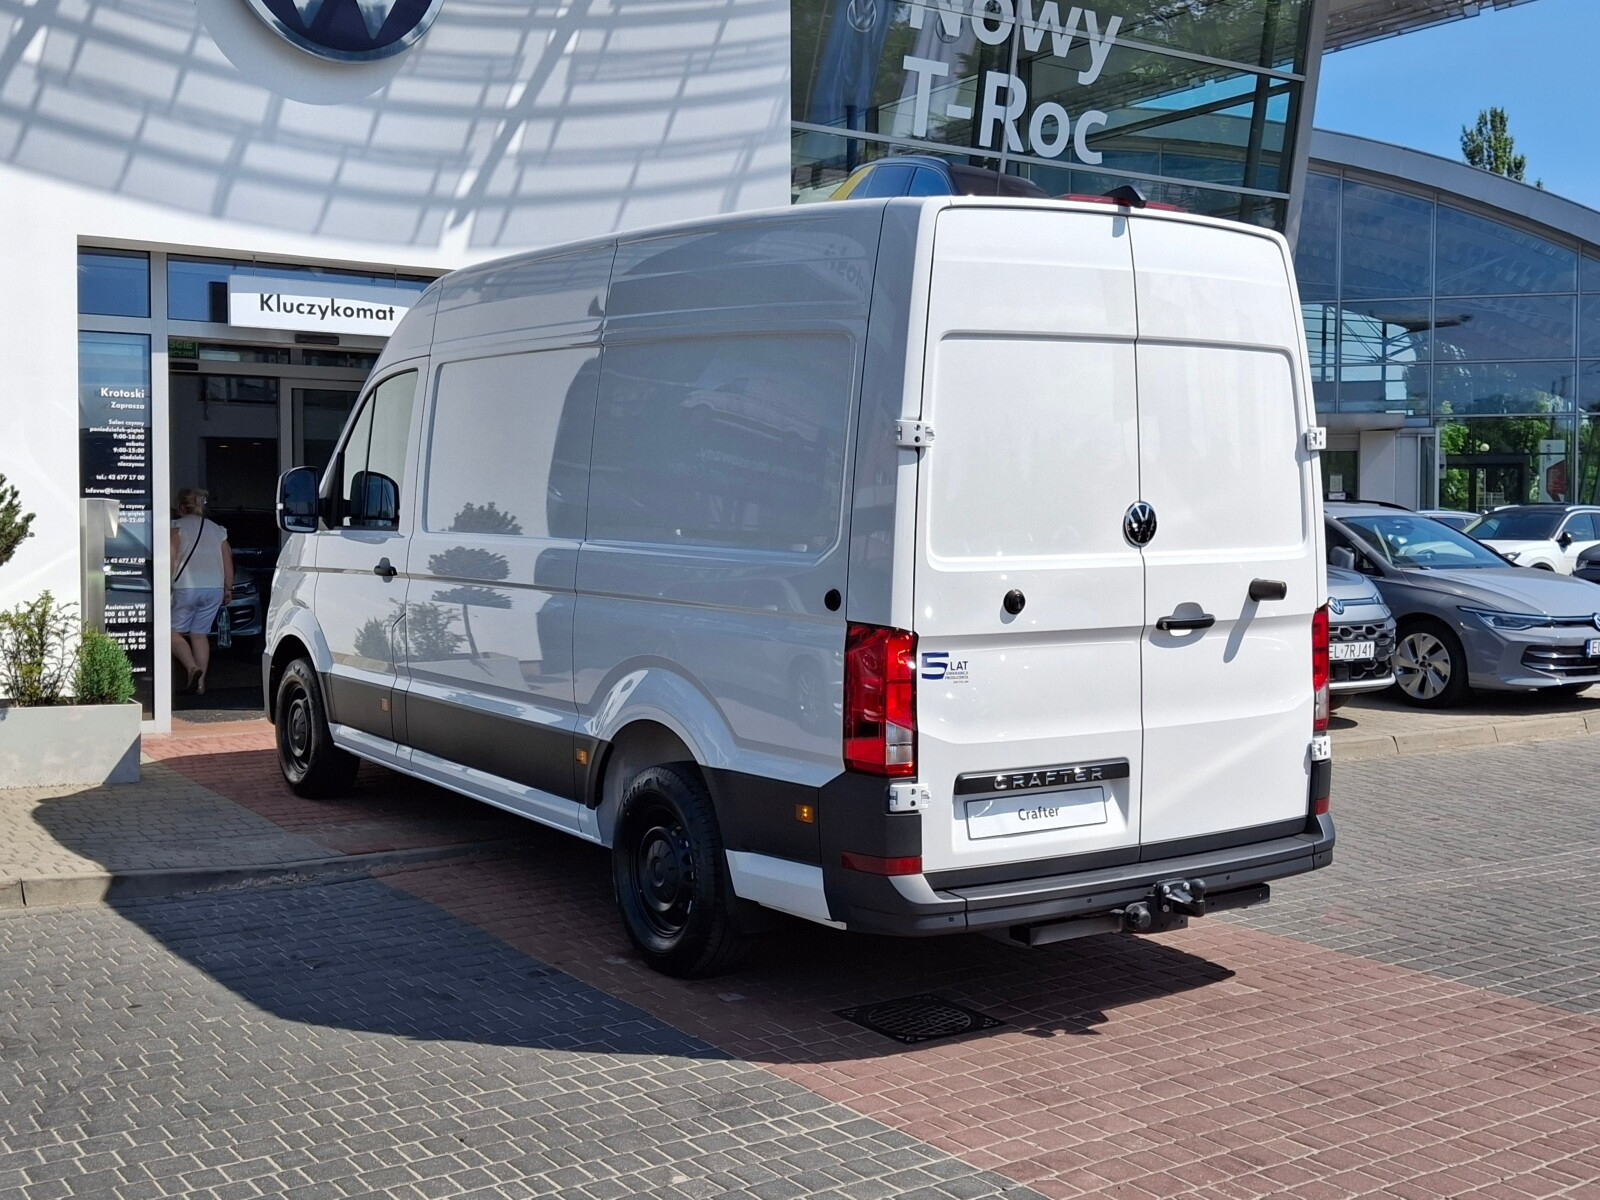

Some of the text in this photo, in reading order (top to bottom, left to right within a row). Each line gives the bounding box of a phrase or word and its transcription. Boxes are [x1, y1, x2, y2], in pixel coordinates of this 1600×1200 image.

[902, 55, 1108, 165] T-Roc
[260, 293, 395, 321] Kluczykomat
[100, 387, 145, 398] Krotoski
[110, 401, 145, 410] Zaprasza
[85, 487, 145, 495] infovw@krotoski.com
[1344, 643, 1373, 658] 7RJ41
[921, 652, 968, 680] 5 LAT
[993, 766, 1103, 790] CRAFTER
[1017, 806, 1060, 821] Crafter
